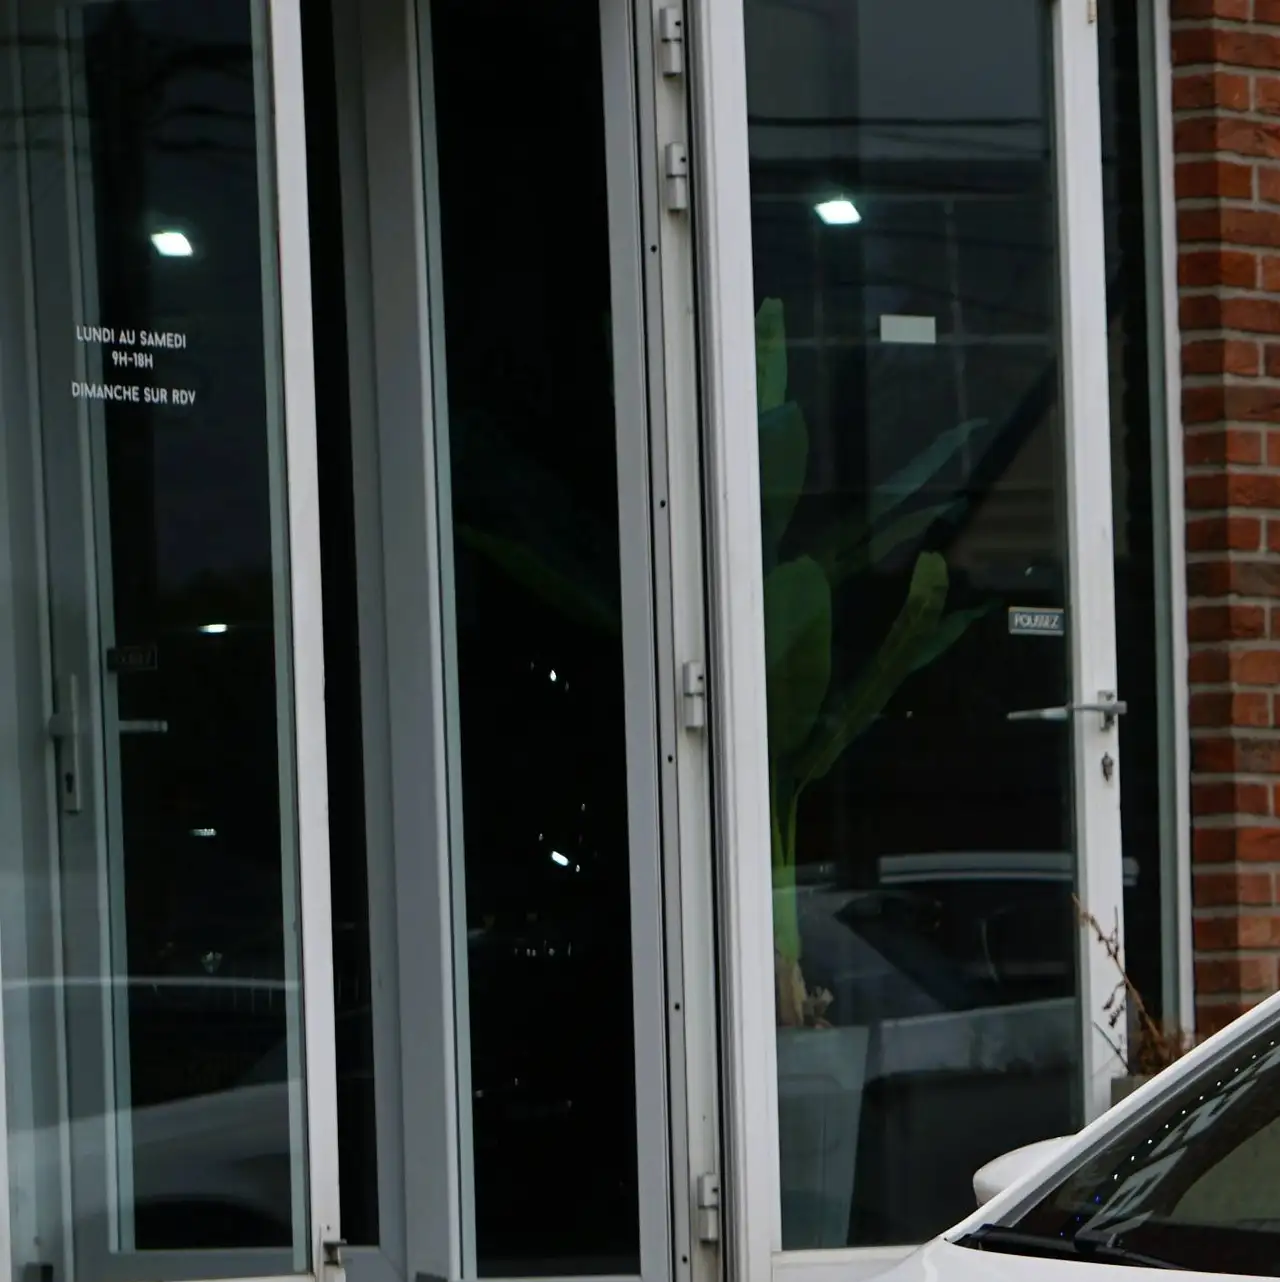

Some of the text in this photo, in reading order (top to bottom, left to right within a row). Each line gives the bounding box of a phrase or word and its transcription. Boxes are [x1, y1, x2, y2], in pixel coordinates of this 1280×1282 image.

[76, 325, 187, 349] LUNDI AU SAMEDI
[112, 350, 154, 369] 9H-18H
[72, 381, 196, 406] DIMANCHE SUR RDV
